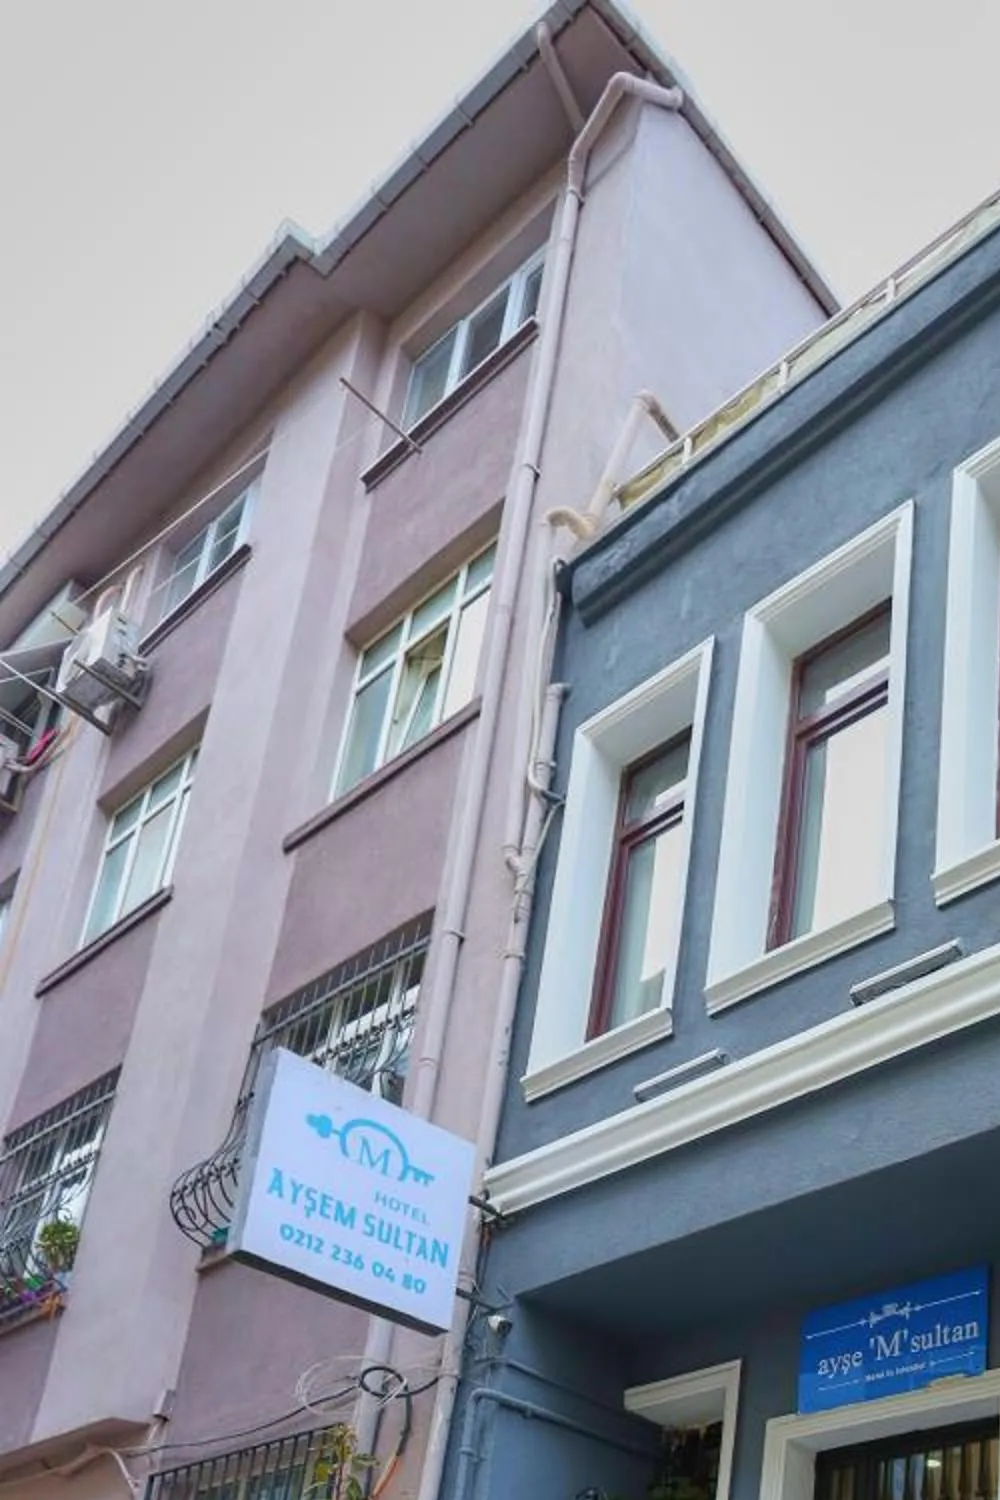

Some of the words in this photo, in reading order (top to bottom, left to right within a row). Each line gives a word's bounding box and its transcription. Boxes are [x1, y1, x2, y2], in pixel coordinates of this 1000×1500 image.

[267, 1167, 358, 1231] AYŞEM
[363, 1212, 450, 1268] SULTAN
[374, 1191, 429, 1225] HOTEL
[279, 1222, 324, 1254] 0212
[331, 1244, 365, 1272] 236
[371, 1260, 395, 1283] 04
[402, 1273, 426, 1295] 80
[817, 1350, 863, 1379] ayşe
[910, 1320, 979, 1352] sultan
